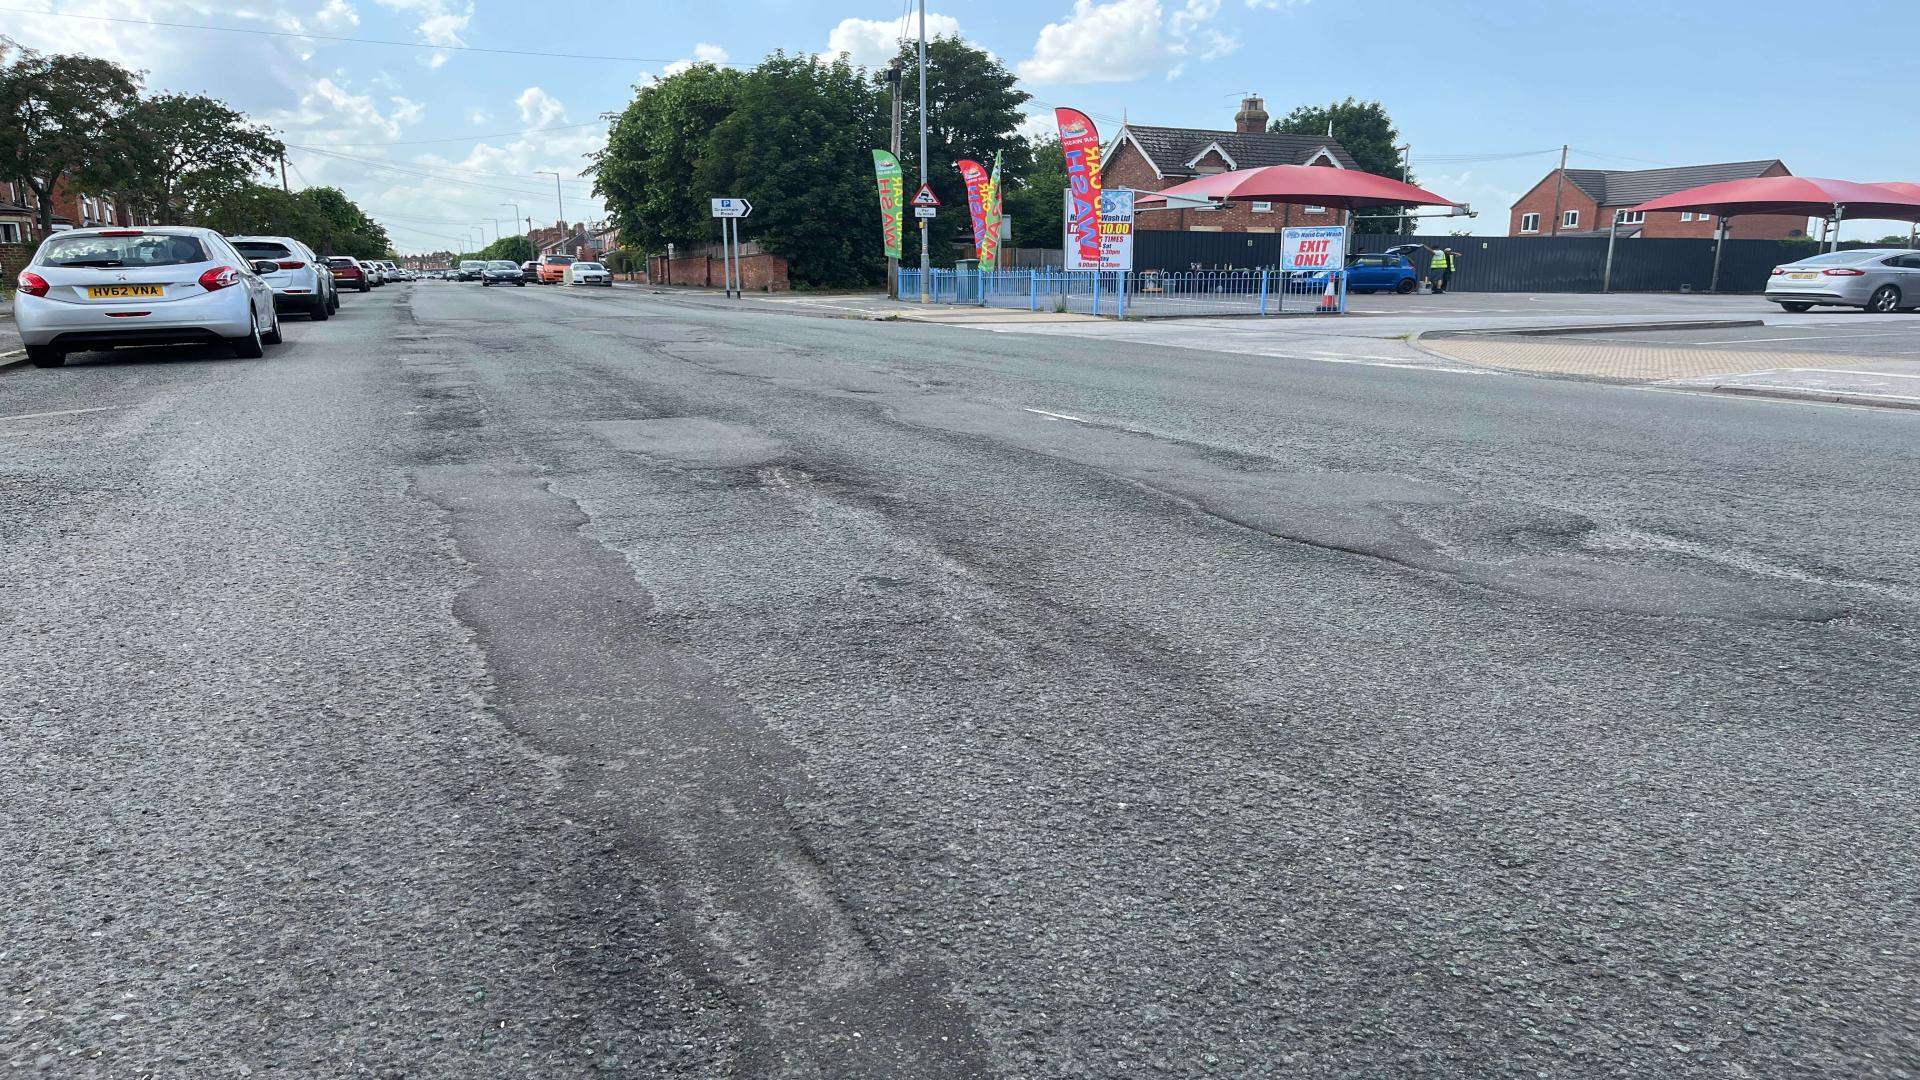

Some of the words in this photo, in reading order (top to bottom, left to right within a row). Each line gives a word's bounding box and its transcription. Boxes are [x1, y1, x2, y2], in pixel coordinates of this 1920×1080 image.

[1101, 214, 1120, 222] Wash
[1121, 214, 1130, 222] Ltd
[1299, 240, 1330, 252] EXIT
[1294, 254, 1328, 266] ONLY
[94, 287, 128, 296] HV62
[131, 286, 158, 295] VNA
